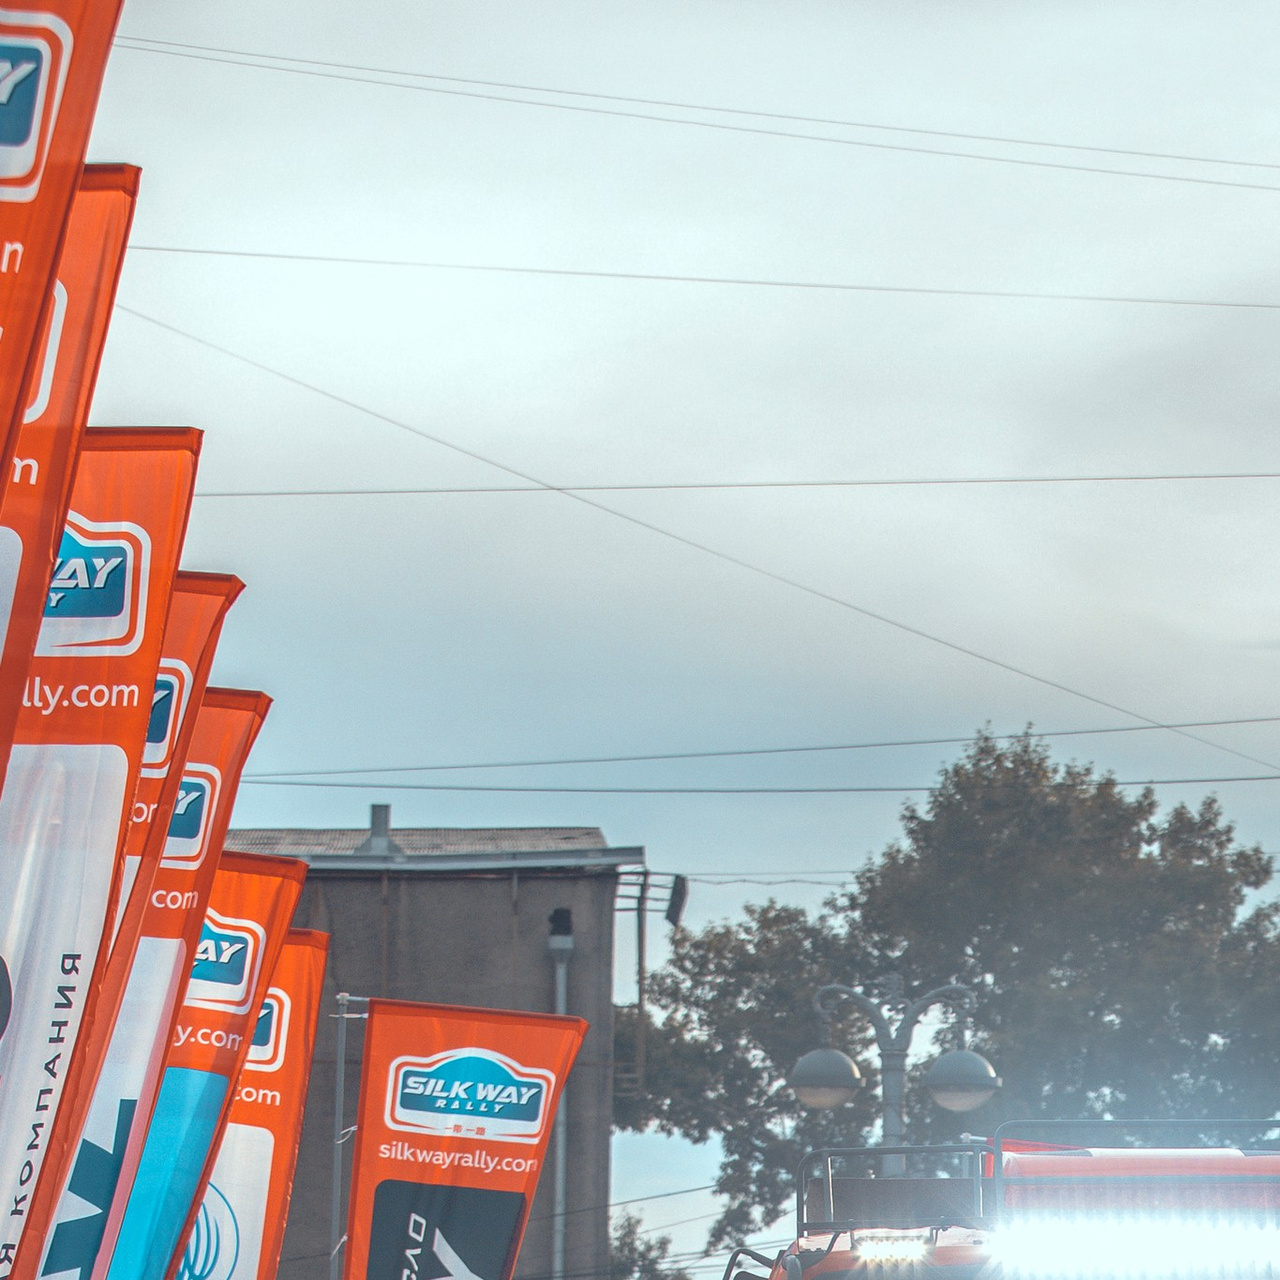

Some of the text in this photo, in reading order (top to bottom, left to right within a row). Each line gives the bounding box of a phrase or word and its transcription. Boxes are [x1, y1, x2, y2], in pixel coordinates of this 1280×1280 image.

[51, 558, 123, 588] AY
[10, 953, 82, 1217] КОМПАНИЯ
[402, 1076, 540, 1105] SILK WAY
[434, 1099, 504, 1113] RALLY
